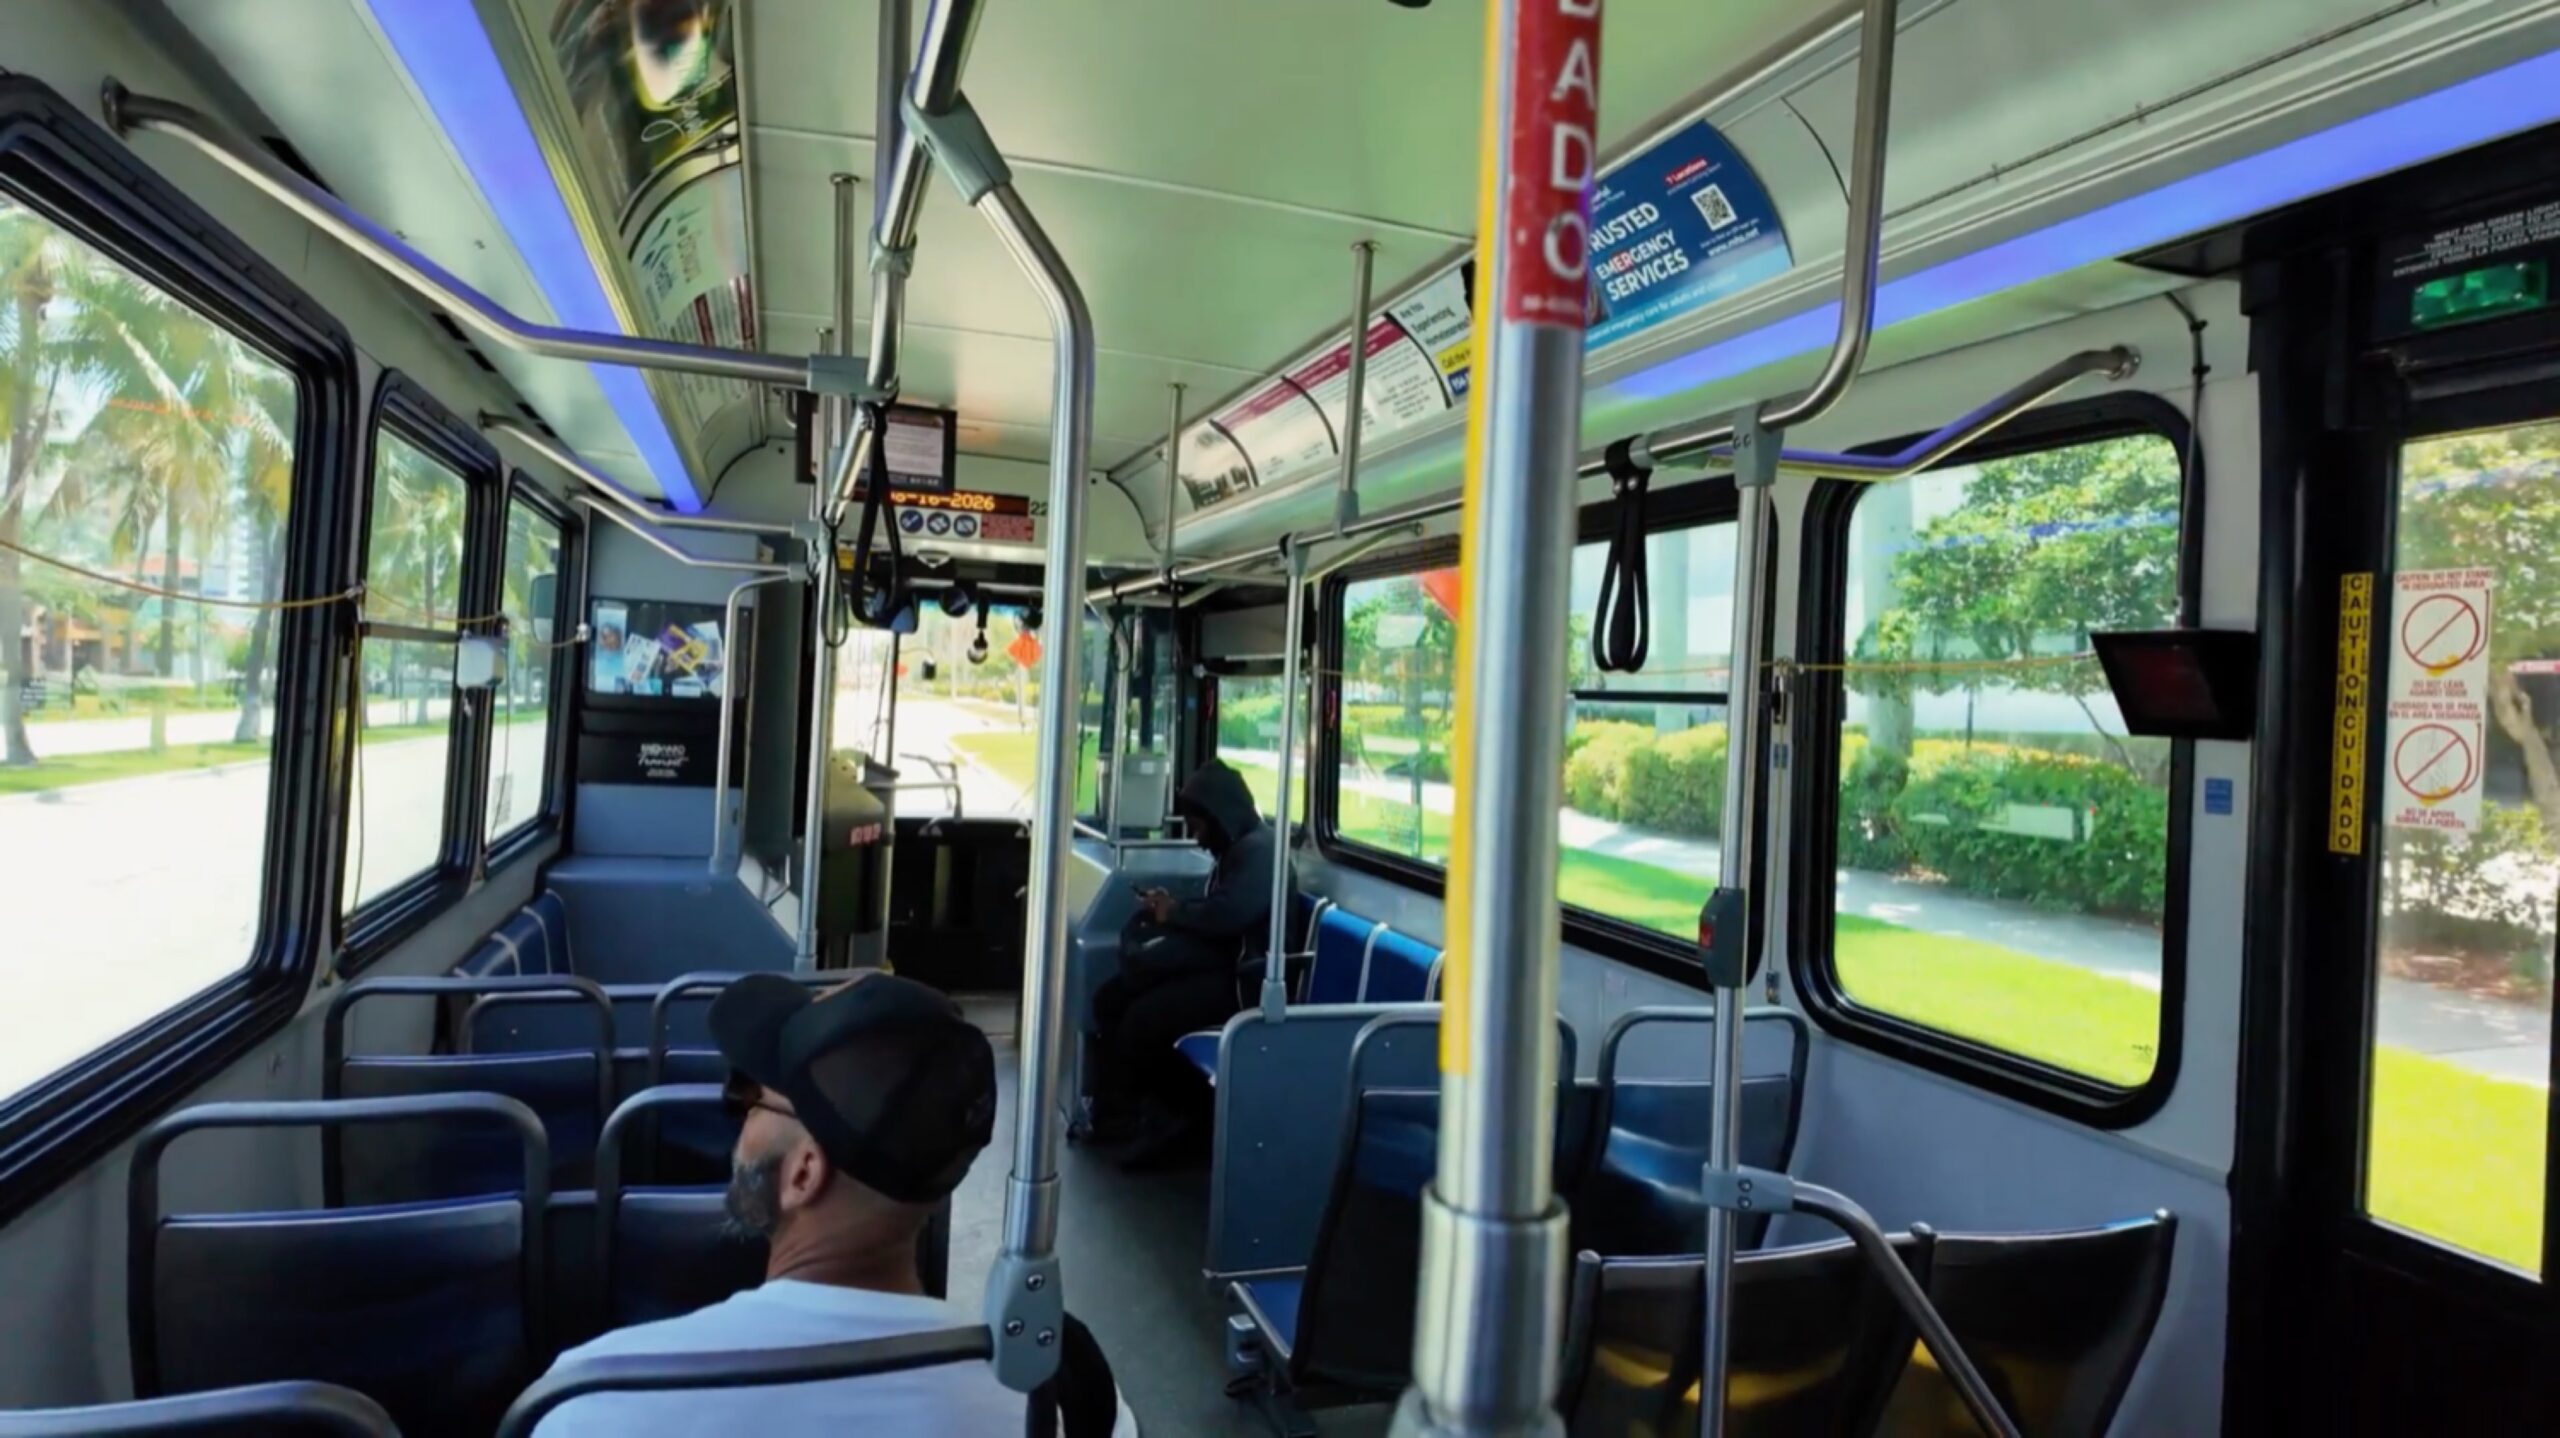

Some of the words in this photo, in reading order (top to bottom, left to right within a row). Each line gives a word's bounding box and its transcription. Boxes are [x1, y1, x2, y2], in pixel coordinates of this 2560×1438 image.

[1543, 0, 1598, 279] ADO
[1588, 202, 1660, 256] RUSTED
[2487, 212, 2524, 227] GREEN
[1595, 228, 1676, 280] EMERGENCY
[1606, 248, 1690, 301] SERVICES
[2344, 575, 2363, 709] CAUTION
[2337, 714, 2357, 849] CUIDADO
